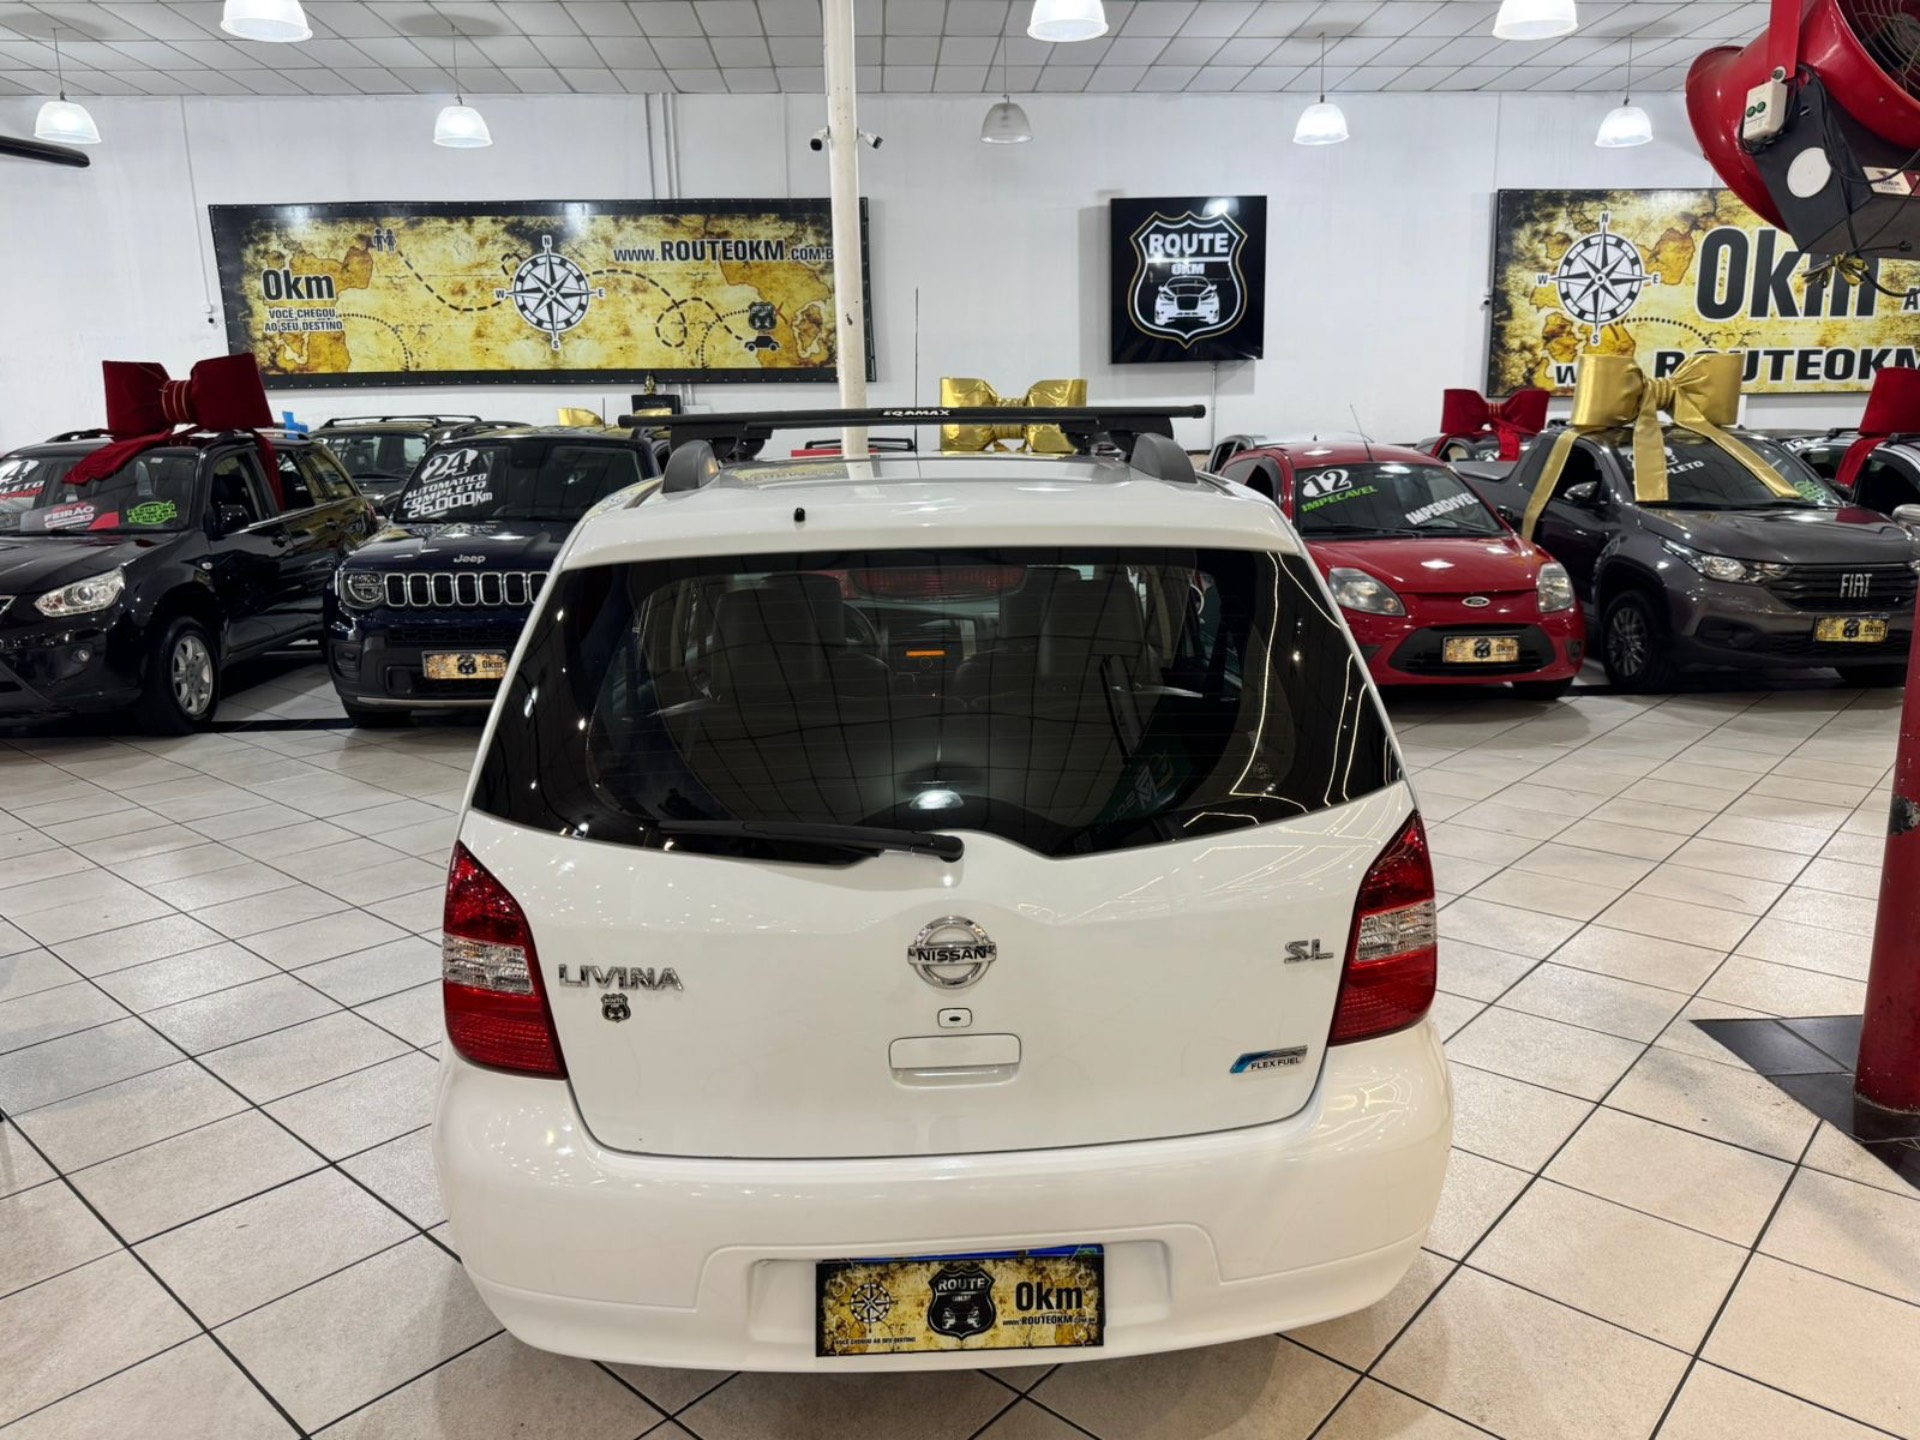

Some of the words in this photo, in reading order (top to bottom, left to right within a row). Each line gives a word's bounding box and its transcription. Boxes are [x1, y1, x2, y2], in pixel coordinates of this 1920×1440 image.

[1148, 233, 1229, 255] ROUTE
[269, 307, 293, 319] VOCÊ
[297, 308, 335, 319] CHEGOU
[265, 321, 278, 332] AO
[281, 322, 299, 331] SEU
[303, 321, 342, 331] DESTINO
[422, 449, 472, 483] 24
[1304, 469, 1352, 497] 12
[402, 481, 487, 510] COMPLETO
[453, 554, 486, 565] Jeep
[1839, 573, 1873, 598] FIAT
[917, 946, 987, 962] NISSAN
[1284, 939, 1334, 964] SL
[558, 964, 684, 991] LIVINA
[1251, 1059, 1276, 1070] FLEX
[1278, 1057, 1301, 1067] FUEL
[938, 1278, 985, 1291] ROUTE
[1016, 1282, 1083, 1311] 0km
